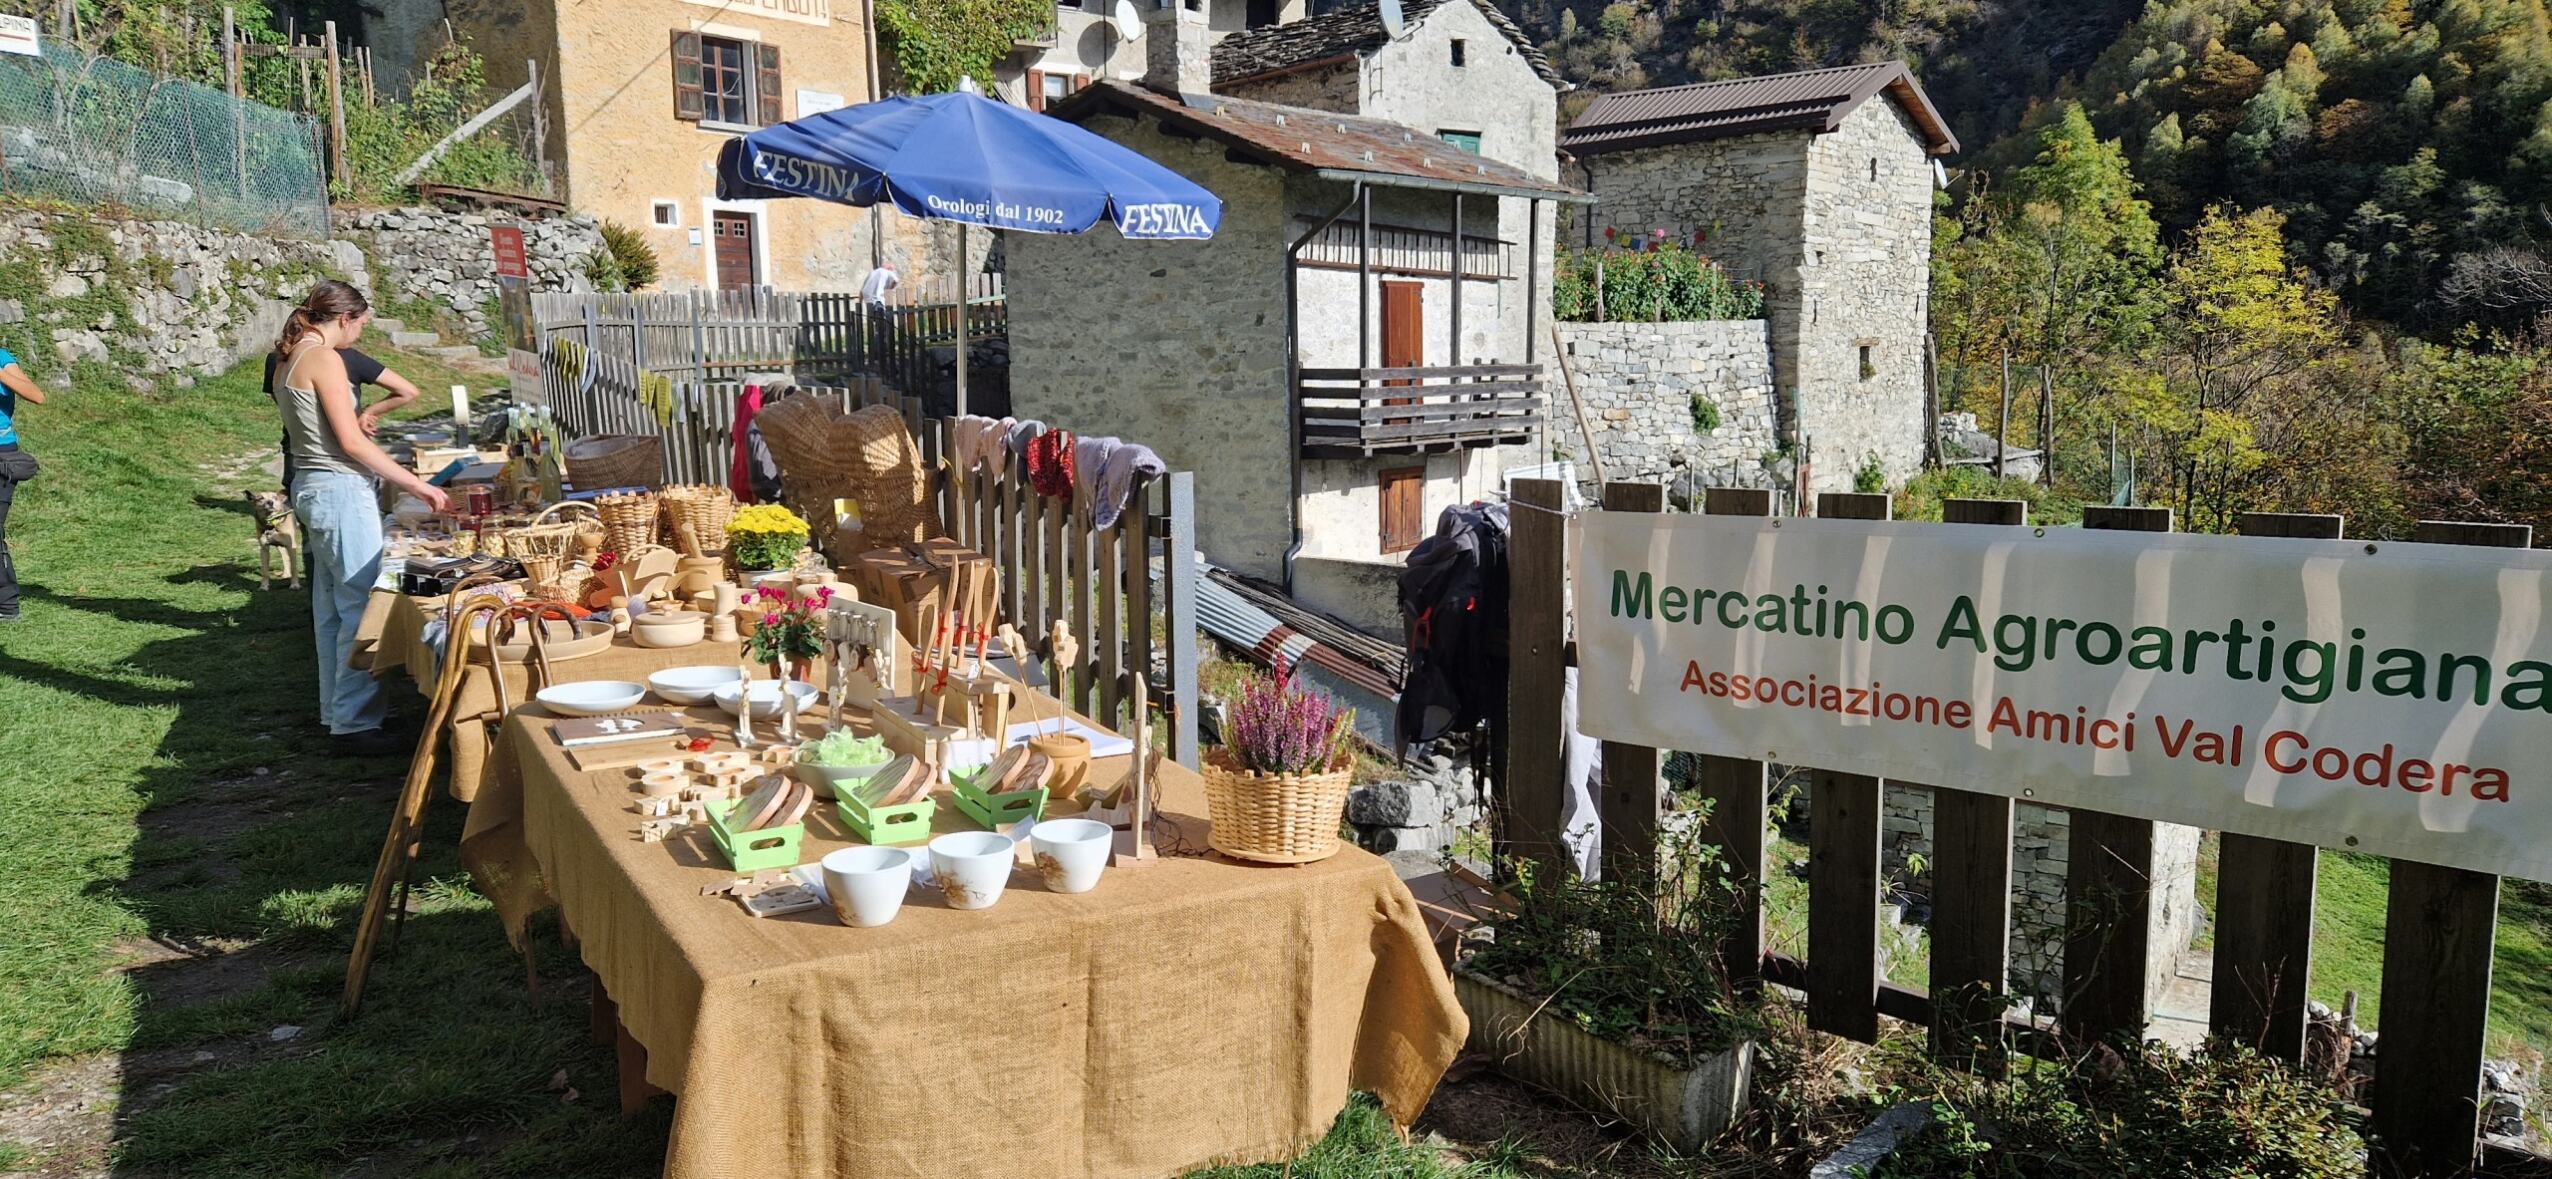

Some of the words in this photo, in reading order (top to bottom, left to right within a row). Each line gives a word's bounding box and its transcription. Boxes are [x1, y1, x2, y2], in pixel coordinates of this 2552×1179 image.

[928, 194, 991, 219] Orologi
[995, 202, 1019, 220] dal
[1026, 206, 1064, 224] 1902
[1611, 569, 1914, 645] Mercatino
[1937, 595, 2552, 714] Agroartigiana
[1680, 659, 1972, 729] Associazione
[1987, 696, 2136, 752] Amici
[2155, 714, 2243, 768] Val
[2264, 730, 2510, 803] Codera
